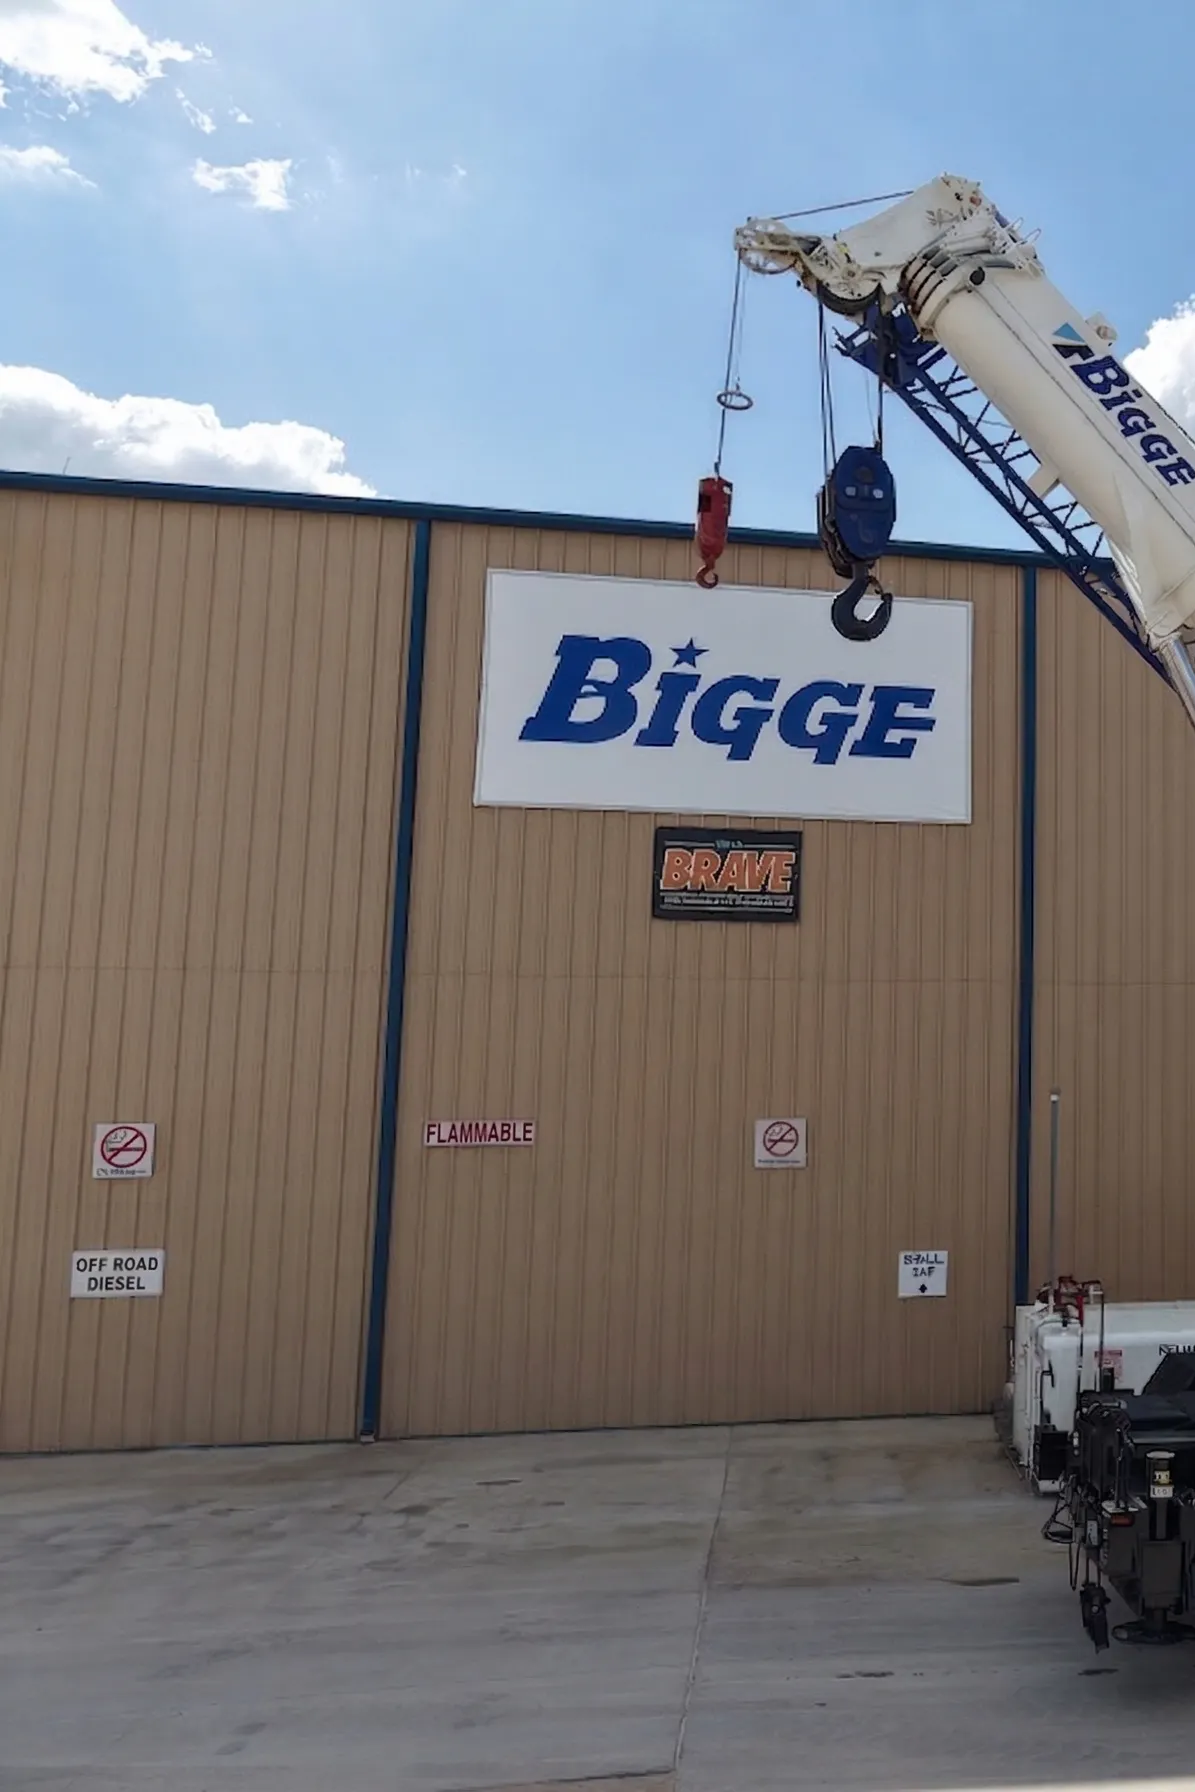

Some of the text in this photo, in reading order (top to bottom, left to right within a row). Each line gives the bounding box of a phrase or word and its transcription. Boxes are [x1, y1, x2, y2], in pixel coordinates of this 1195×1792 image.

[660, 848, 796, 892] BRAVE
[426, 1122, 533, 1143] FLAMMABLE
[76, 1256, 159, 1272] OFF ROAD
[87, 1276, 146, 1292] DIESEL
